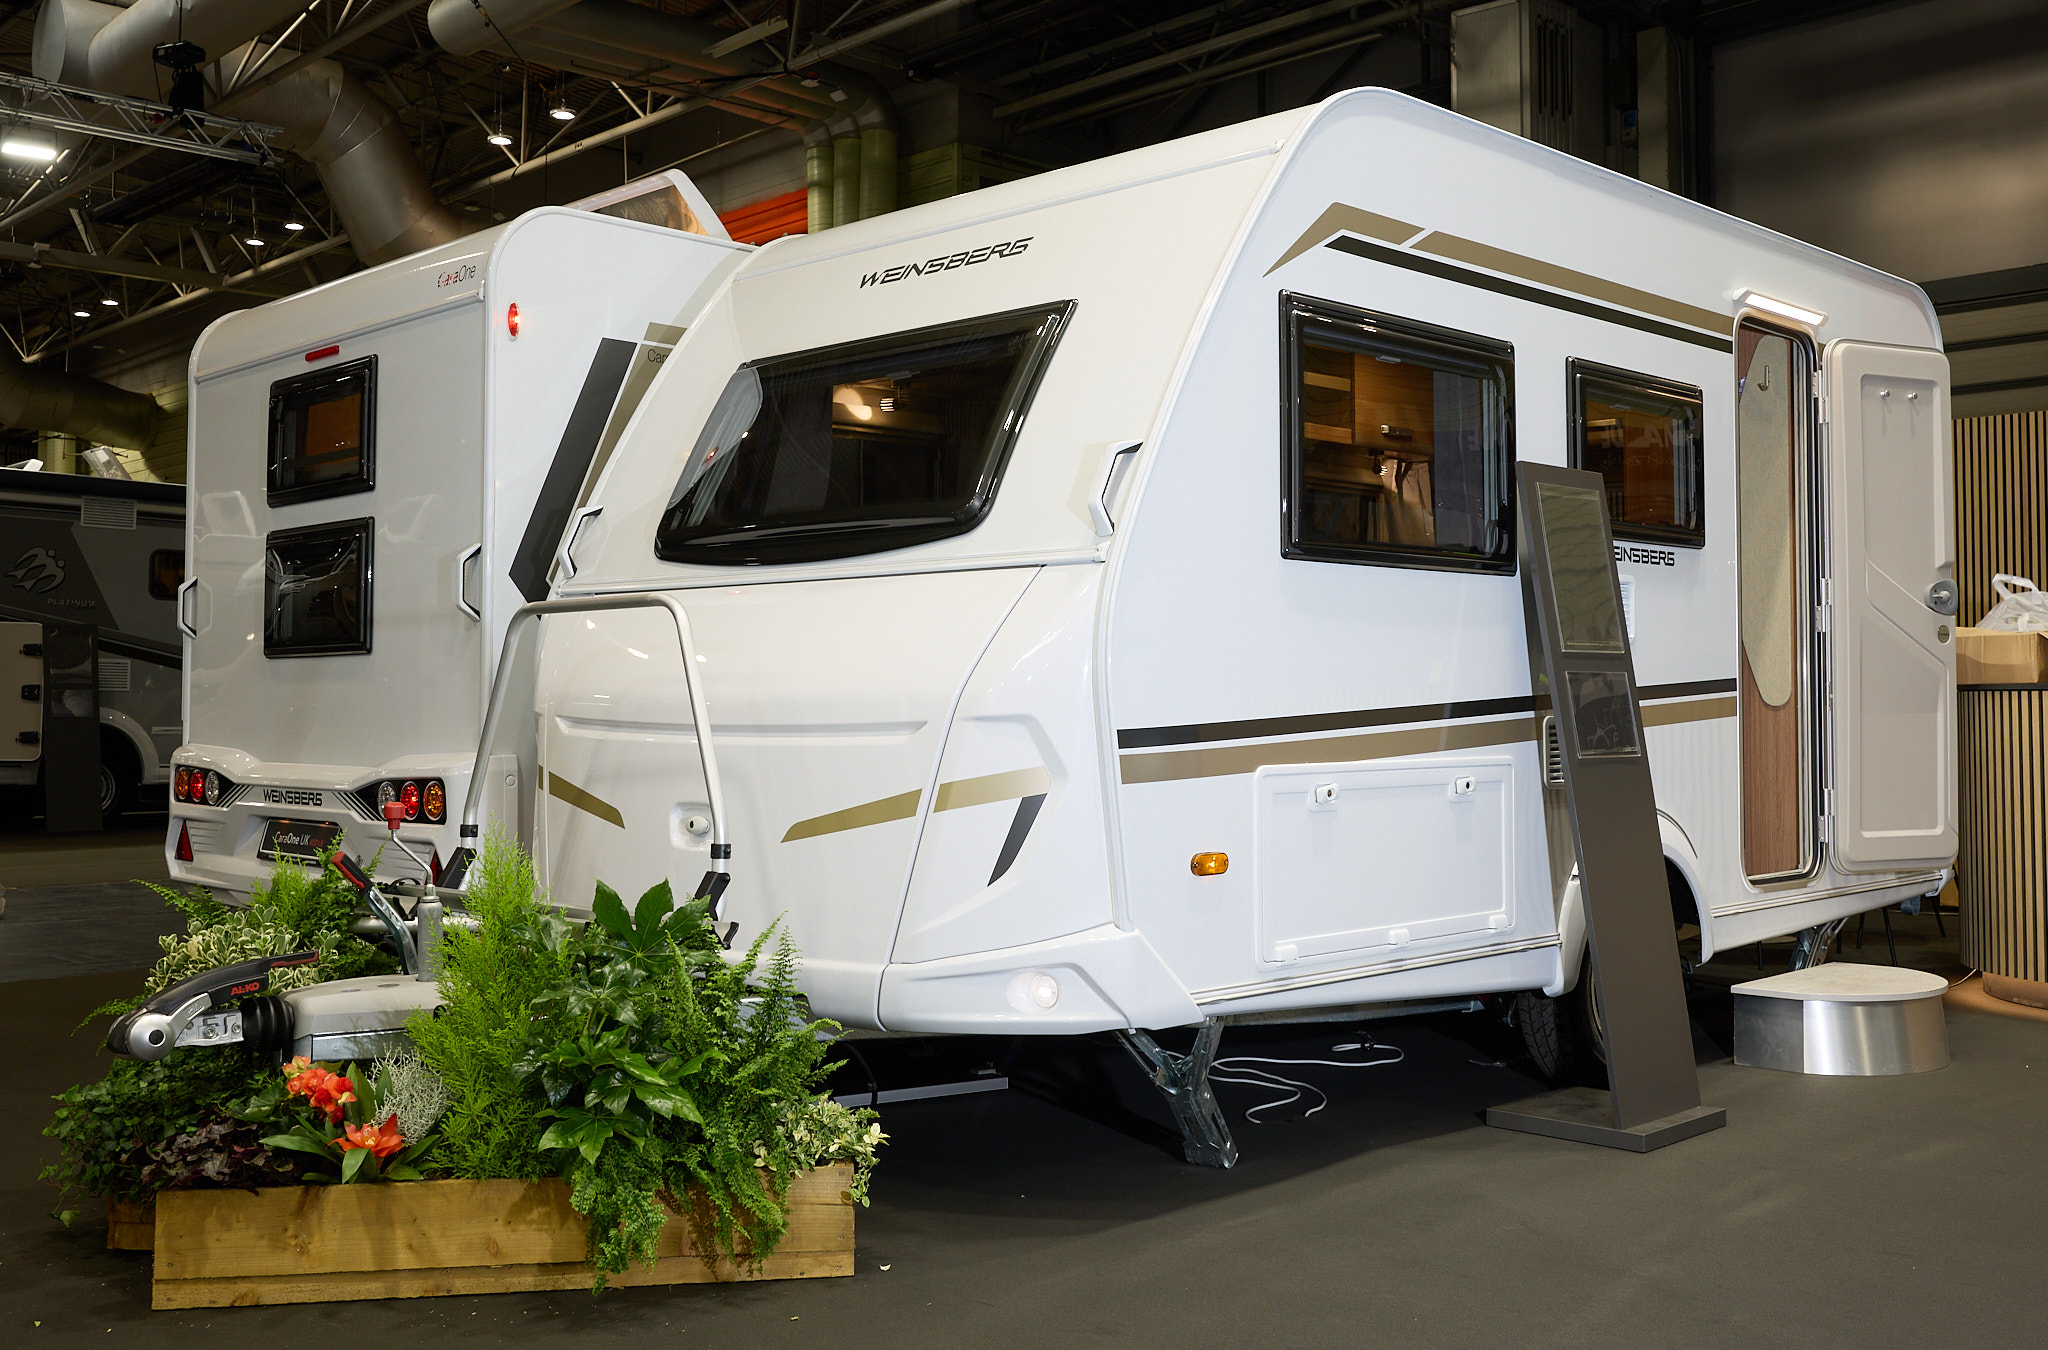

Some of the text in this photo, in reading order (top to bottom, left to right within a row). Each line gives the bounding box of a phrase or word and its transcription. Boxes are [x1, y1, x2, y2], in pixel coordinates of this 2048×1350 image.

[860, 236, 1035, 289] WEINSBERG
[647, 348, 670, 364] Car
[1613, 545, 1675, 567] EINSBERG
[47, 598, 95, 607] PLATINUM
[263, 788, 323, 807] WEINSBERG
[274, 831, 300, 845] CaraOne
[300, 834, 311, 846] UK
